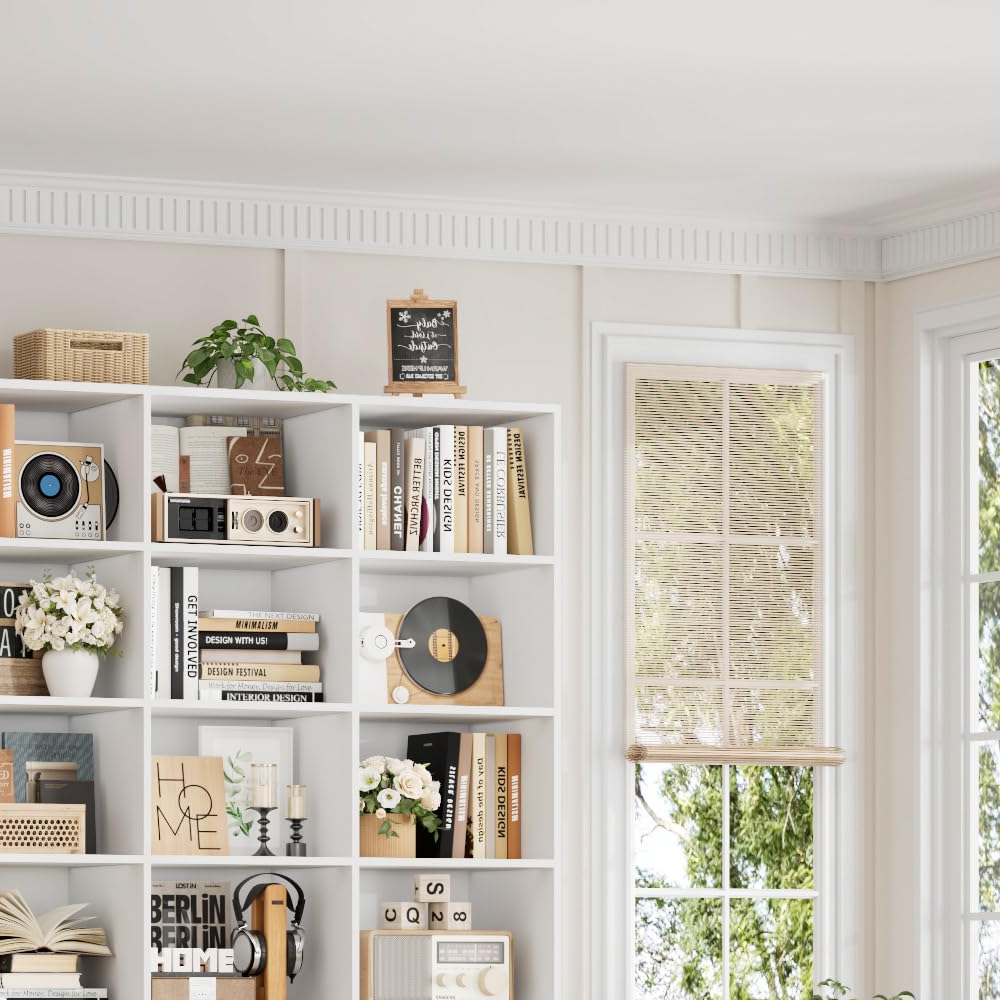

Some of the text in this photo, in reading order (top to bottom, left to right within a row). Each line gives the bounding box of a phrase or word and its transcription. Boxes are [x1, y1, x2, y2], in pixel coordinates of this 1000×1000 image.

[235, 620, 278, 629] MINIMALISM
[188, 595, 197, 678] GET INVOLVED
[205, 636, 268, 644] DESIGN WITH US!
[207, 668, 266, 676] DESIGN FESTIVAL
[226, 693, 307, 702] INTERIOR DESIGN
[406, 907, 420, 924] Q
[151, 948, 234, 973] HOME
